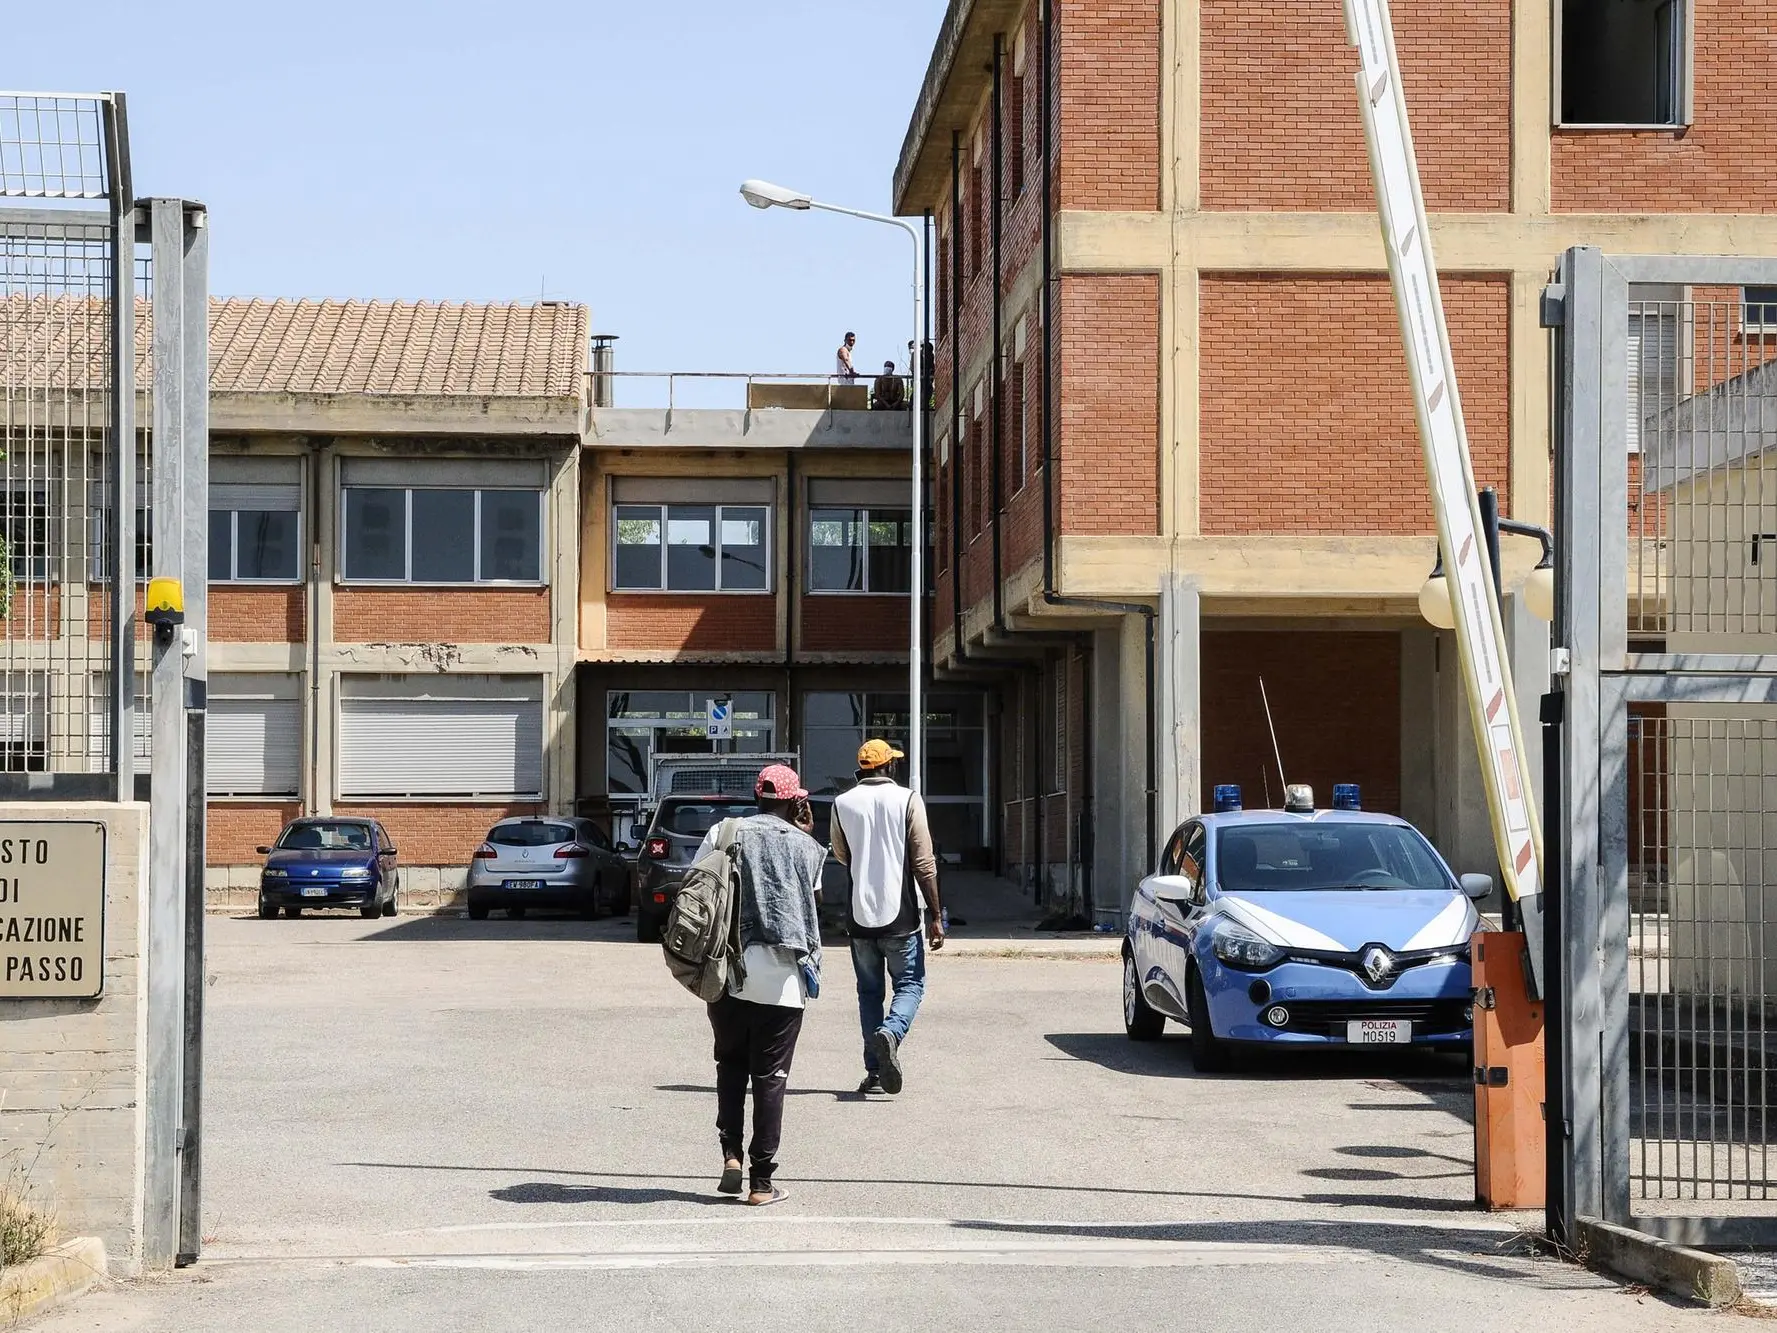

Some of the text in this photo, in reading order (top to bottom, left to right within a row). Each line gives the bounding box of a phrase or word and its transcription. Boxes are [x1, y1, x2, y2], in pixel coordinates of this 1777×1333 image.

[1, 839, 48, 864] STO
[0, 917, 84, 942] AZIONE
[6, 957, 83, 981] PASSO
[1361, 1021, 1397, 1029] POLIZIA
[1363, 1031, 1396, 1041] M0519
